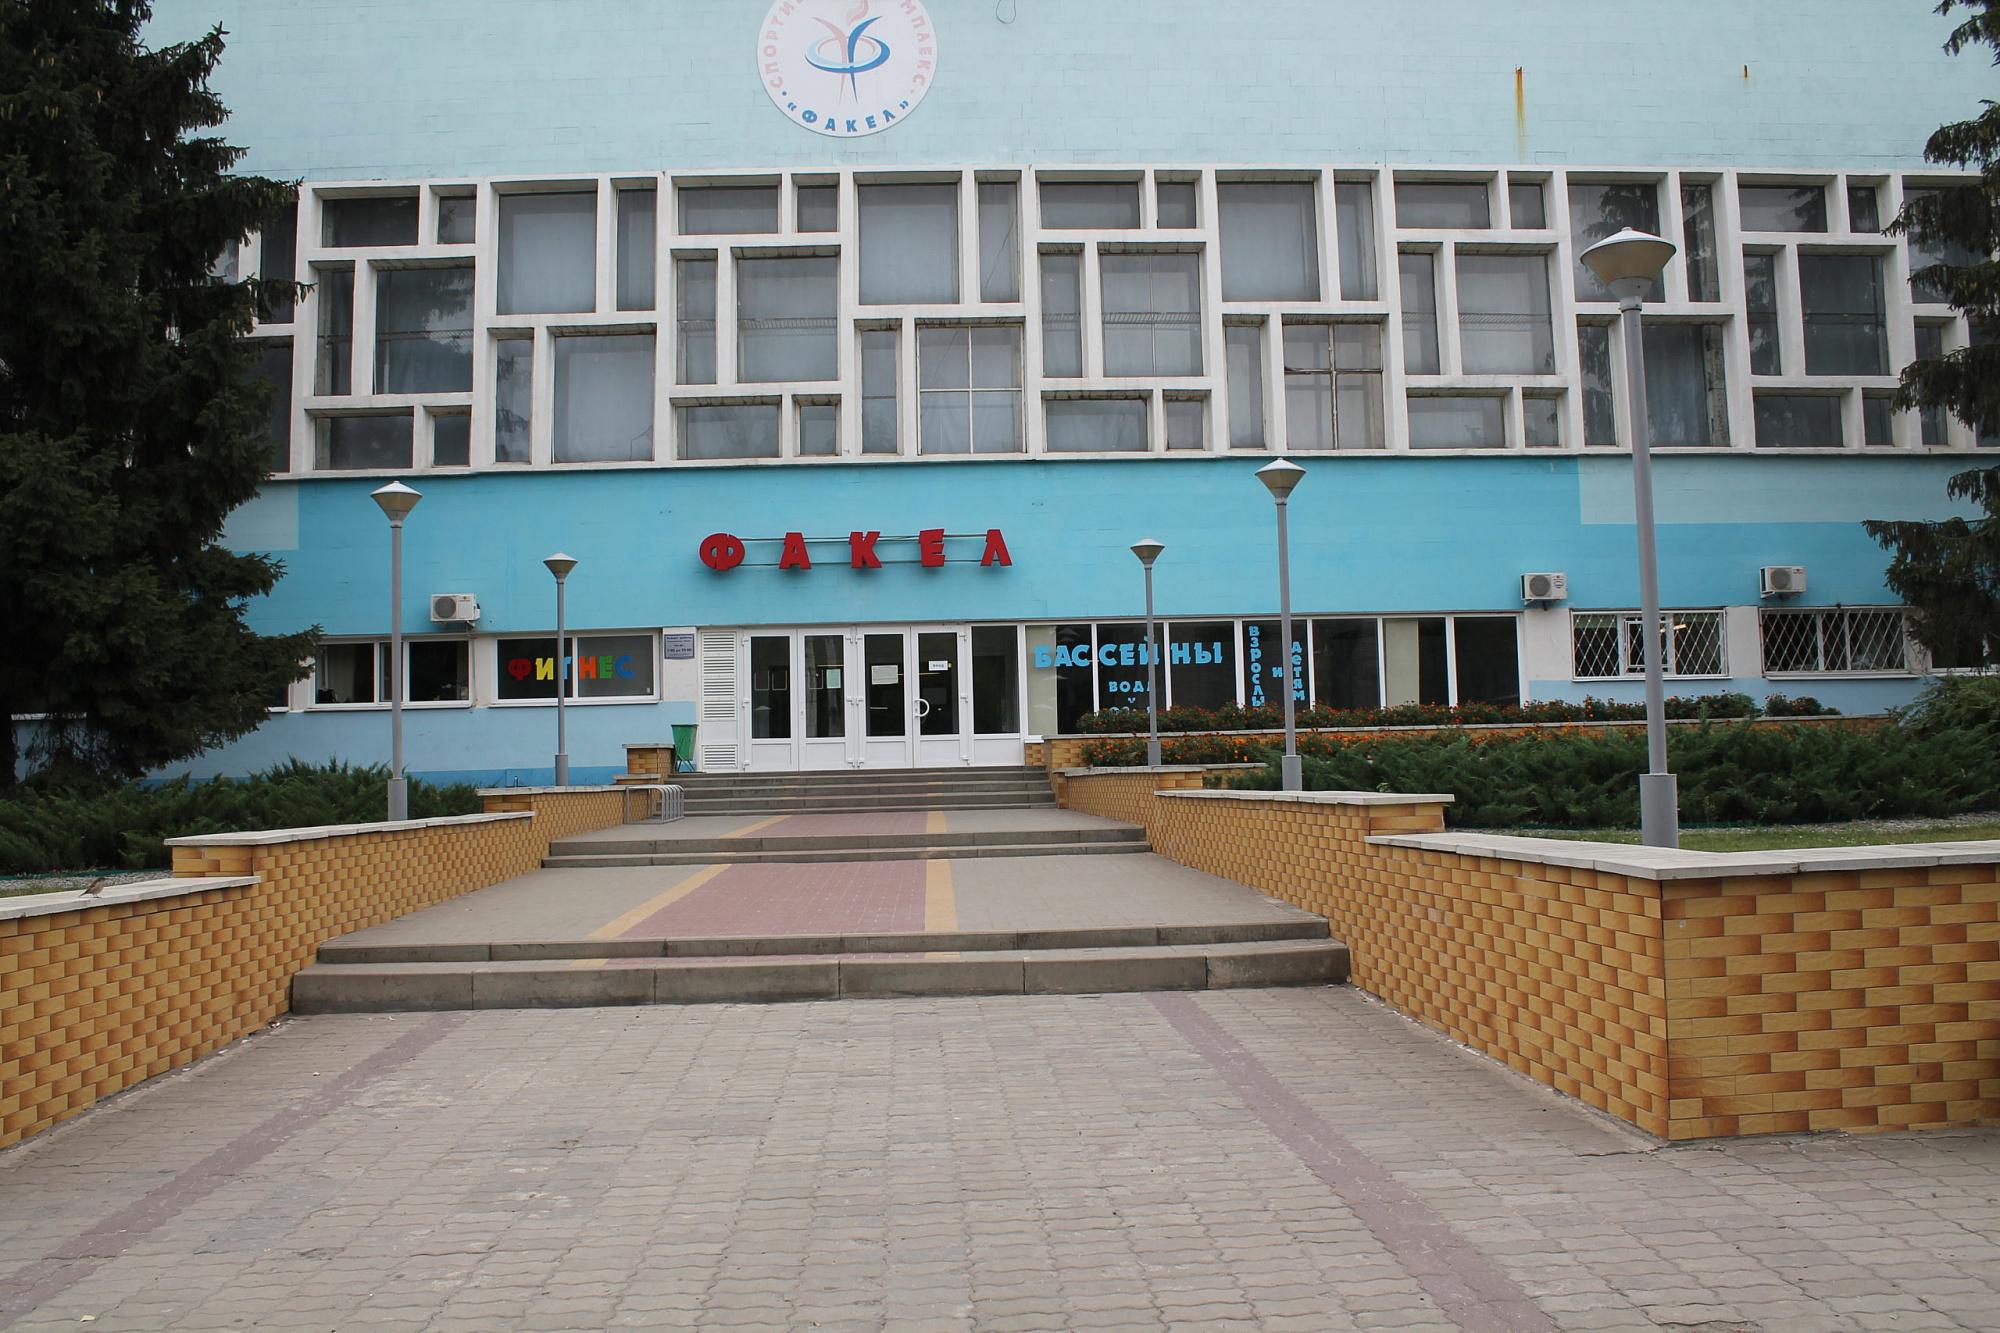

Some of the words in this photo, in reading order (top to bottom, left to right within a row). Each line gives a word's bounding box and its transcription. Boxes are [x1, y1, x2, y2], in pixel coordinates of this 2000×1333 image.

[763, 0, 797, 88] СПОРТИ
[699, 528, 1012, 571] ФАКЕЛ
[1108, 681, 1152, 693] ВОД
